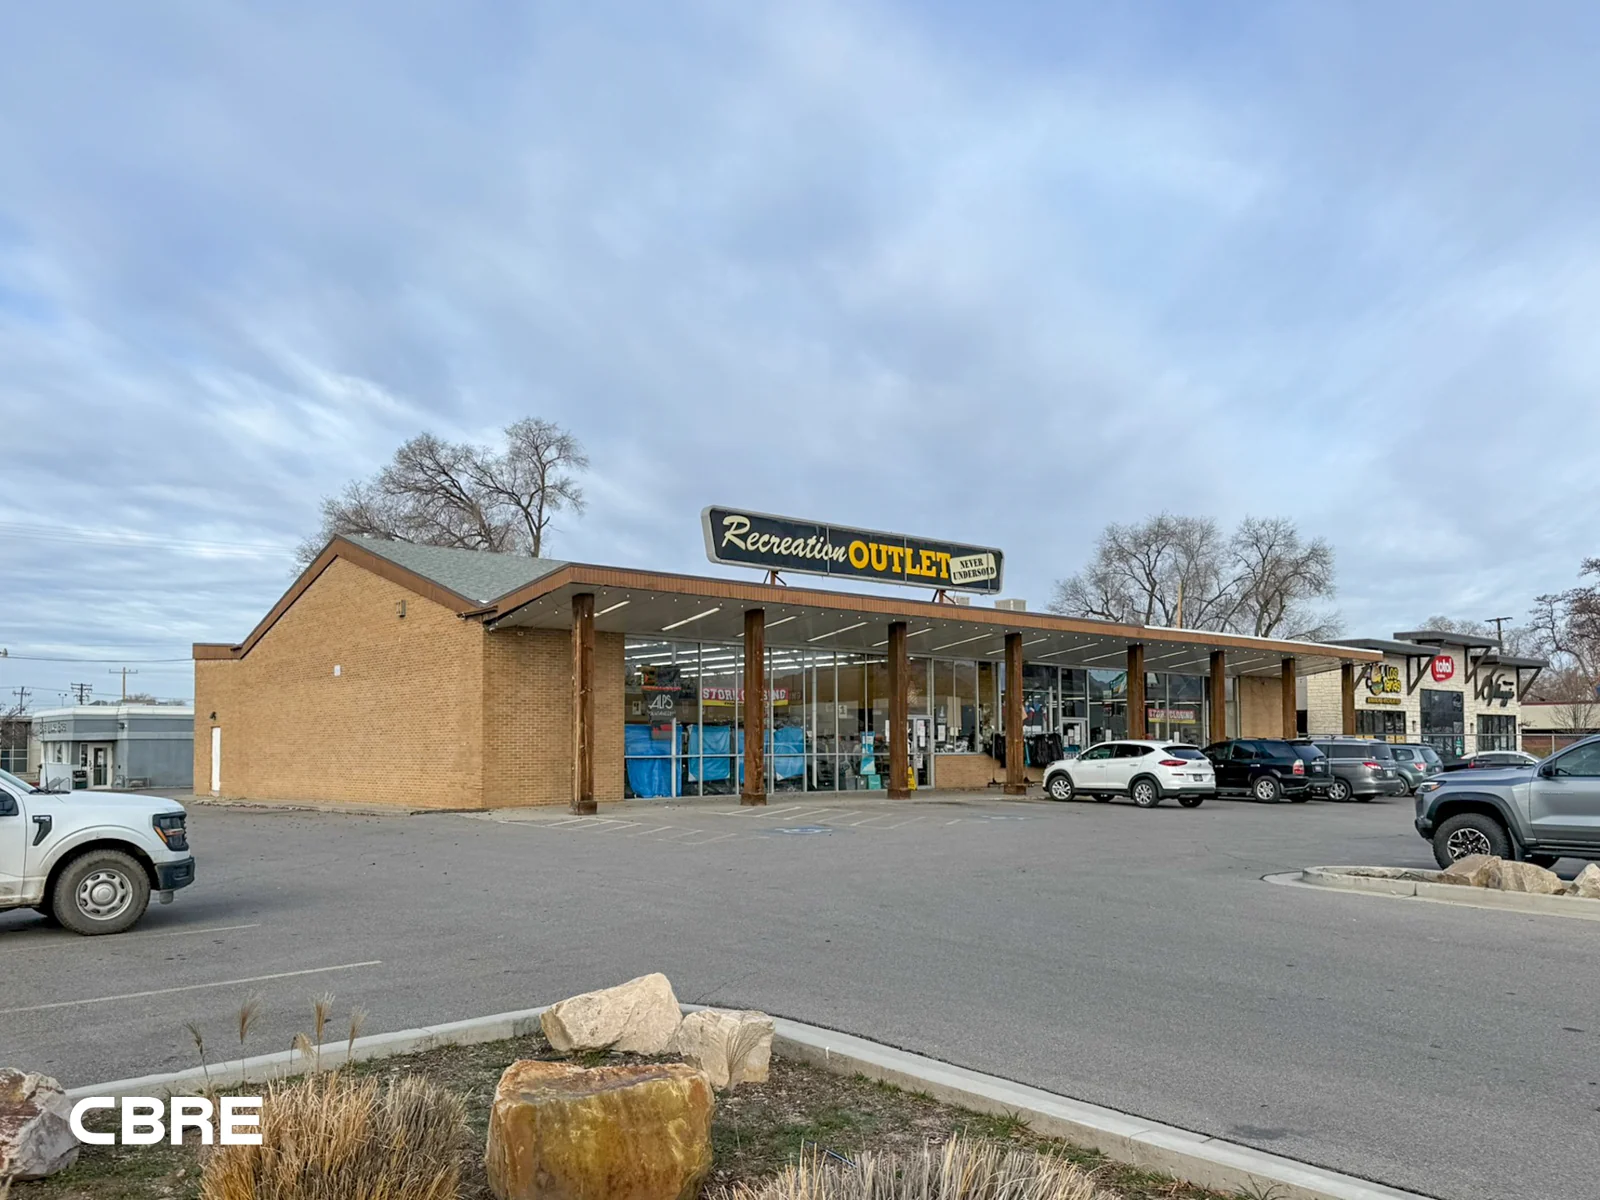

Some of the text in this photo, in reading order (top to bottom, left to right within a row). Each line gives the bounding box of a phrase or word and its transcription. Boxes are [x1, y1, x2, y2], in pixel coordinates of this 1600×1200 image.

[722, 515, 951, 579] Recreation OUTLET
[960, 558, 984, 569] NEVER
[953, 567, 995, 580] UNDERSOLD
[1435, 658, 1452, 673] total
[648, 694, 674, 709] ALPS
